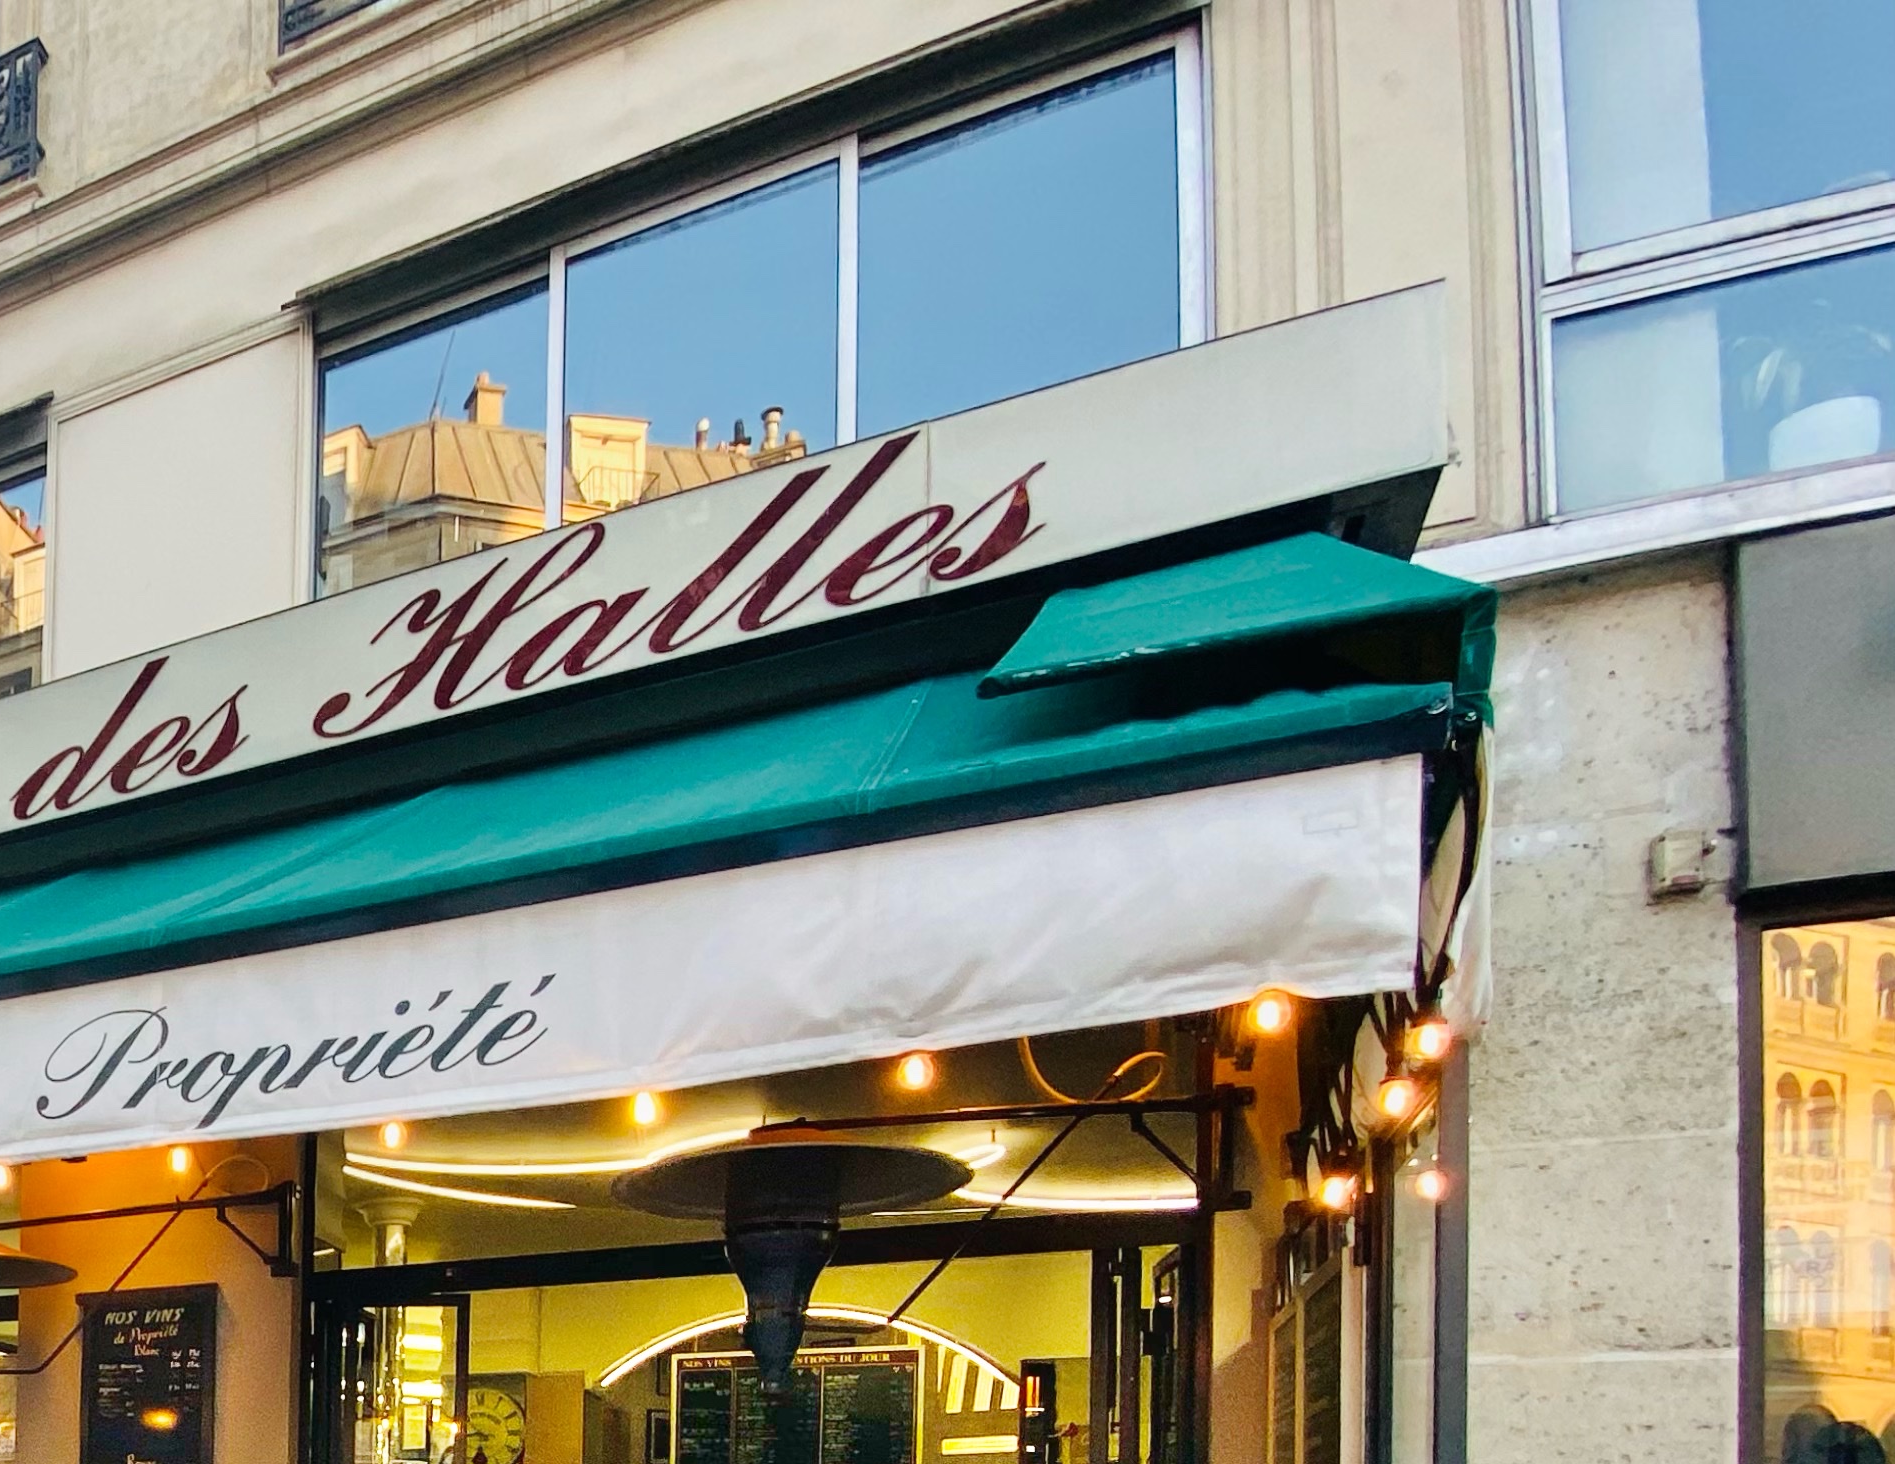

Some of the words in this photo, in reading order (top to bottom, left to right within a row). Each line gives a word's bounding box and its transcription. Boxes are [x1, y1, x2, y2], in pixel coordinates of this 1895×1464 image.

[11, 655, 250, 822] des
[312, 431, 1049, 739] Halles
[37, 973, 557, 1129] Propriété
[105, 1310, 137, 1326] NOS
[144, 1307, 185, 1323] VINS
